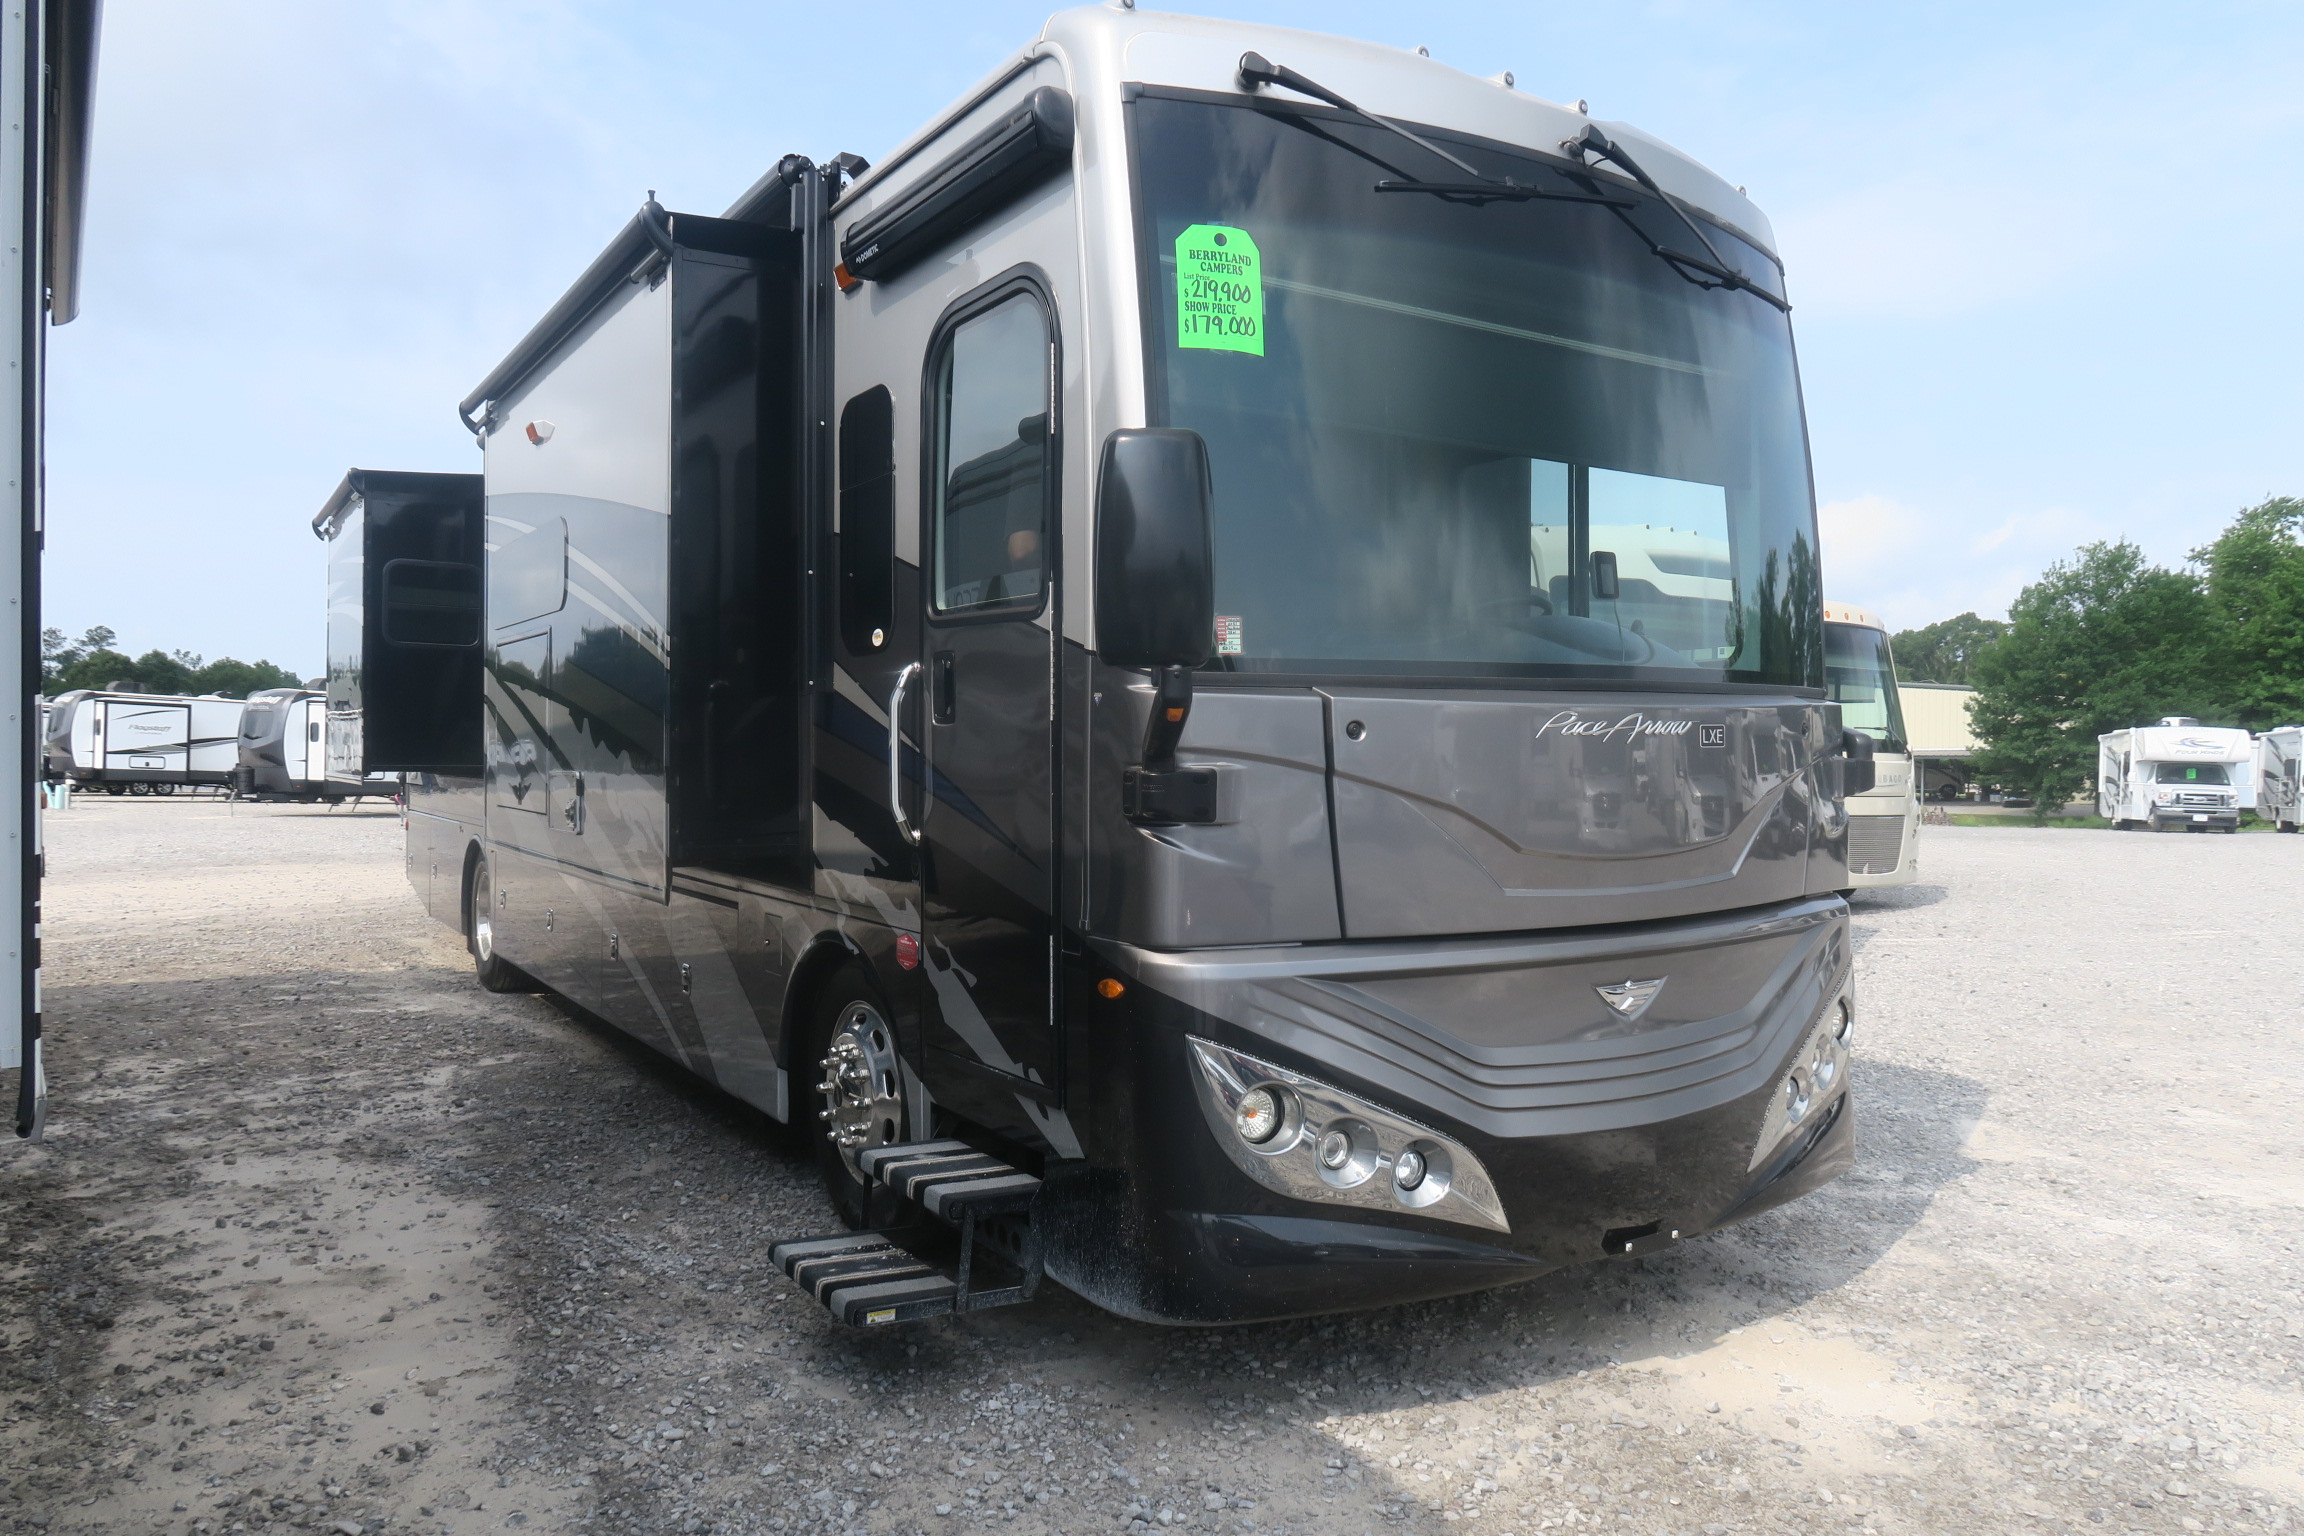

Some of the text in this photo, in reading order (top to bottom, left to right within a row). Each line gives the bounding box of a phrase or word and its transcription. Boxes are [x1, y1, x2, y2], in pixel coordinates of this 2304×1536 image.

[1188, 249, 1252, 266] BERRYLAND
[1200, 262, 1243, 276] CAMPERS
[1183, 272, 1211, 281] List Price
[1184, 301, 1237, 315] SHOW PRICE
[1535, 710, 1698, 744] Pace Arrow
[1702, 728, 1723, 743] LXE
